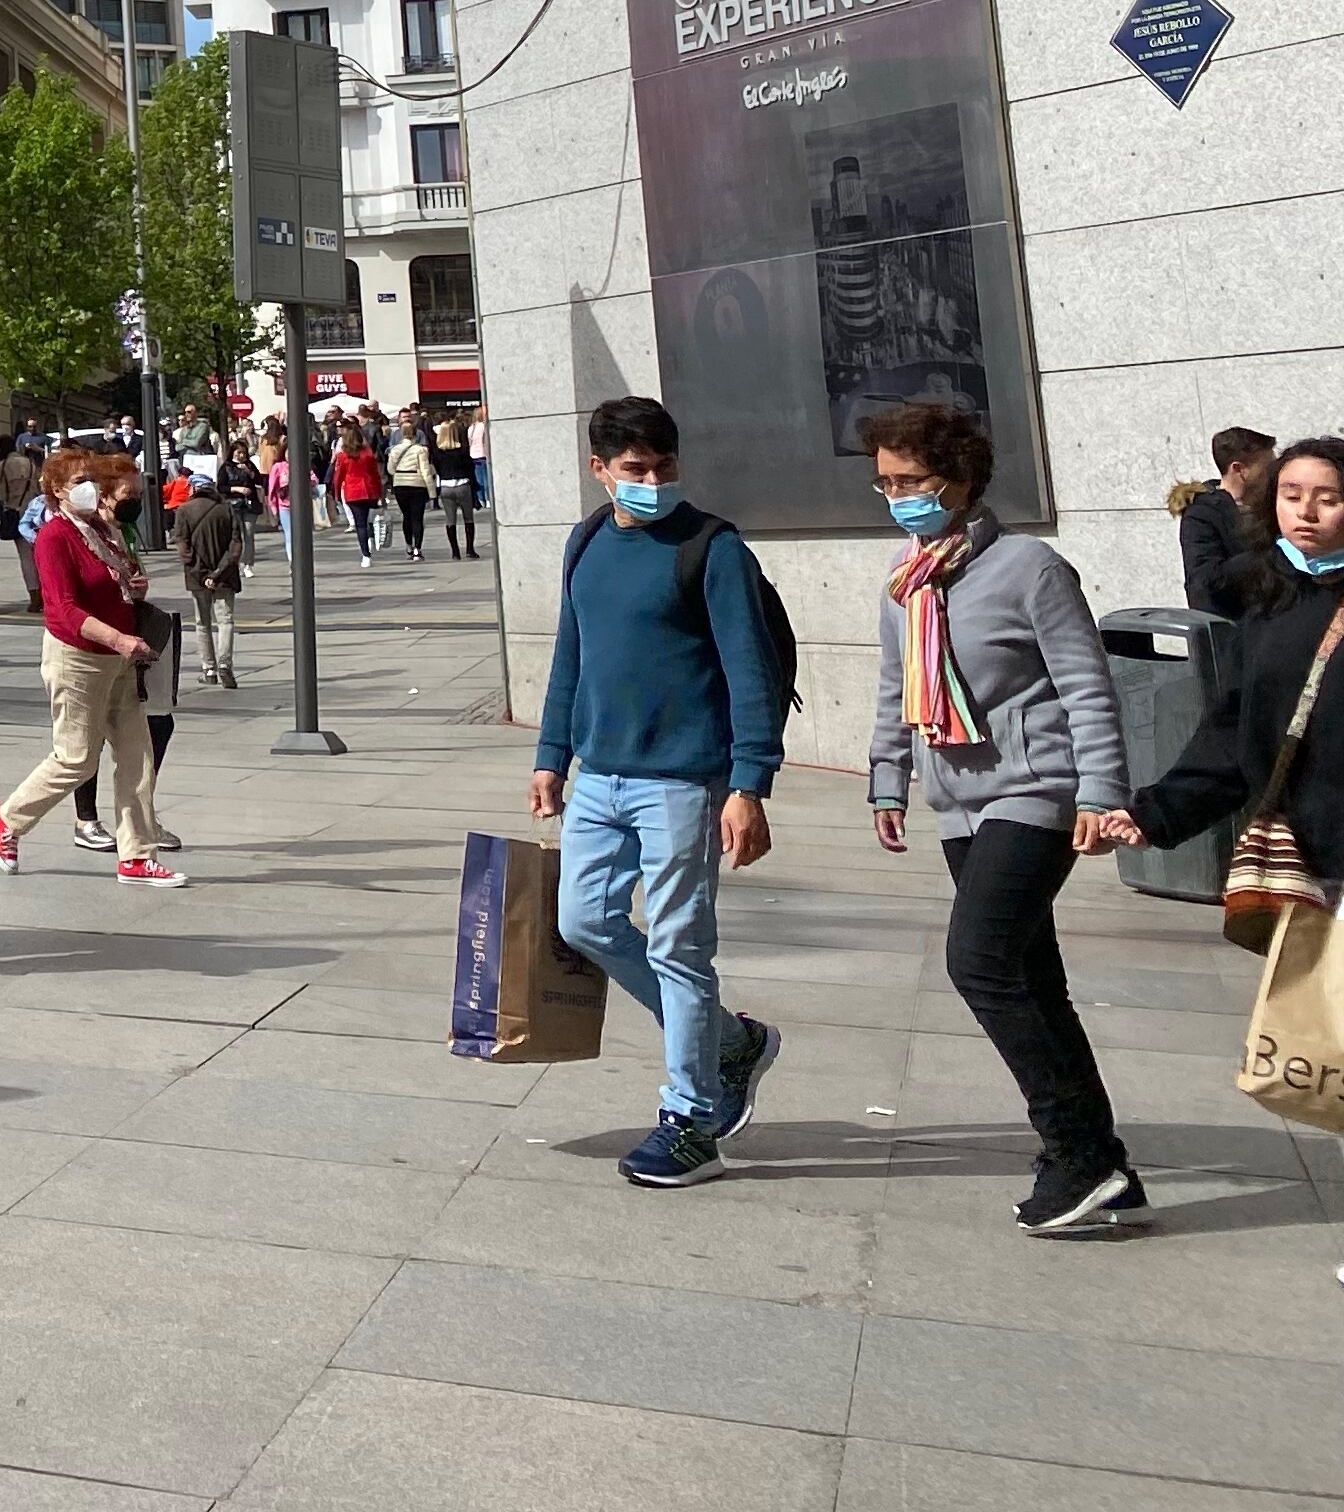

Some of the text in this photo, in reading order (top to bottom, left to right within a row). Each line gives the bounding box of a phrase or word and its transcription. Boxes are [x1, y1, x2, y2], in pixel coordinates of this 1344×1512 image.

[740, 45, 792, 69] GRAN
[742, 66, 848, 109] El Corte Inglés
[314, 232, 336, 247] TEVA
[317, 373, 344, 383] FIVE
[315, 383, 348, 393] GUYS
